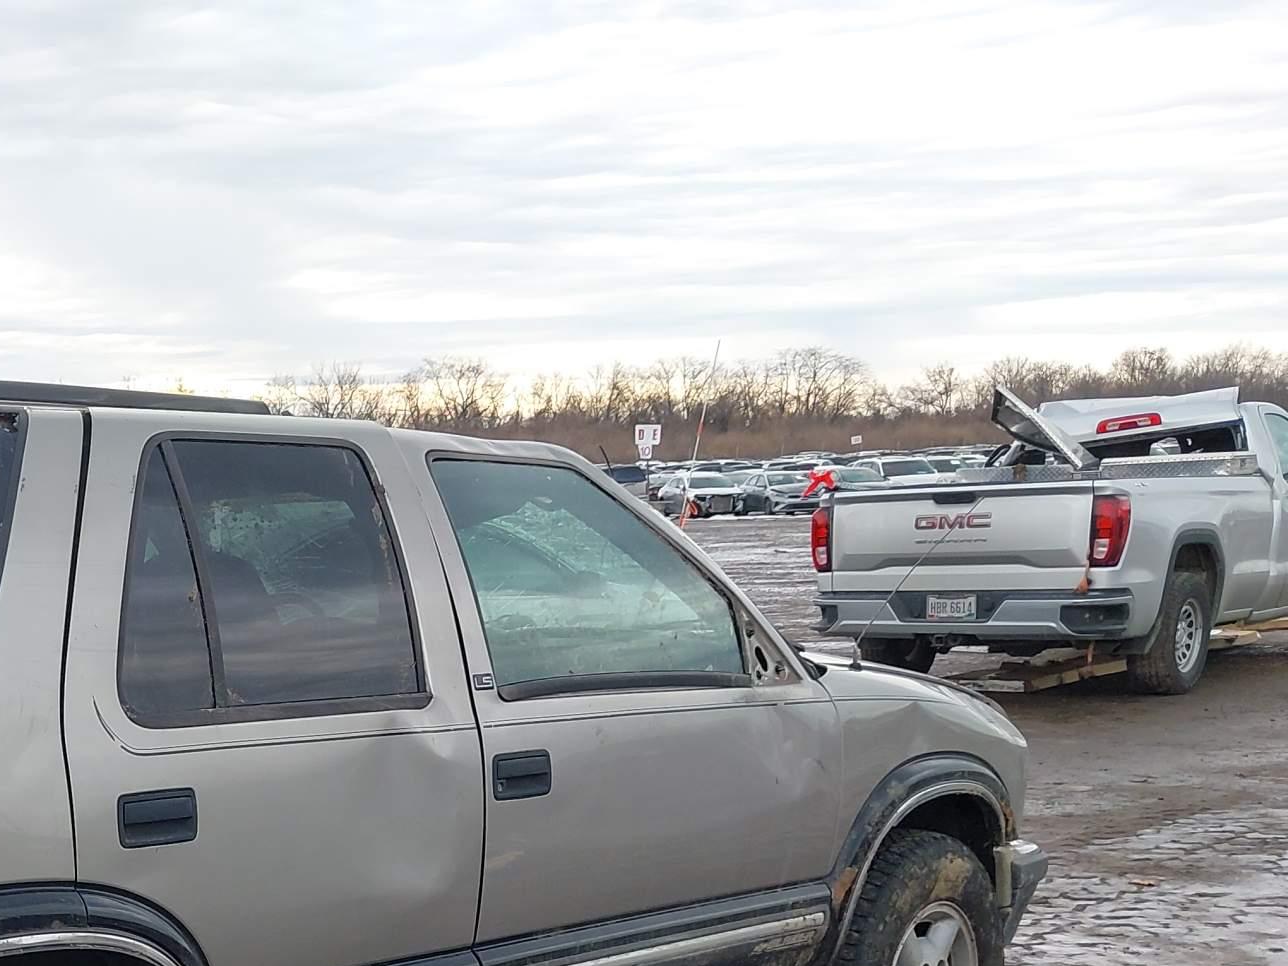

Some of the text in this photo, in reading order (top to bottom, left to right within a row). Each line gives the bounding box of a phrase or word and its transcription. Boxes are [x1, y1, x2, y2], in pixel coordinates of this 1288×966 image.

[638, 429, 645, 441] D
[914, 512, 992, 530] GMC
[474, 676, 493, 688] LS
